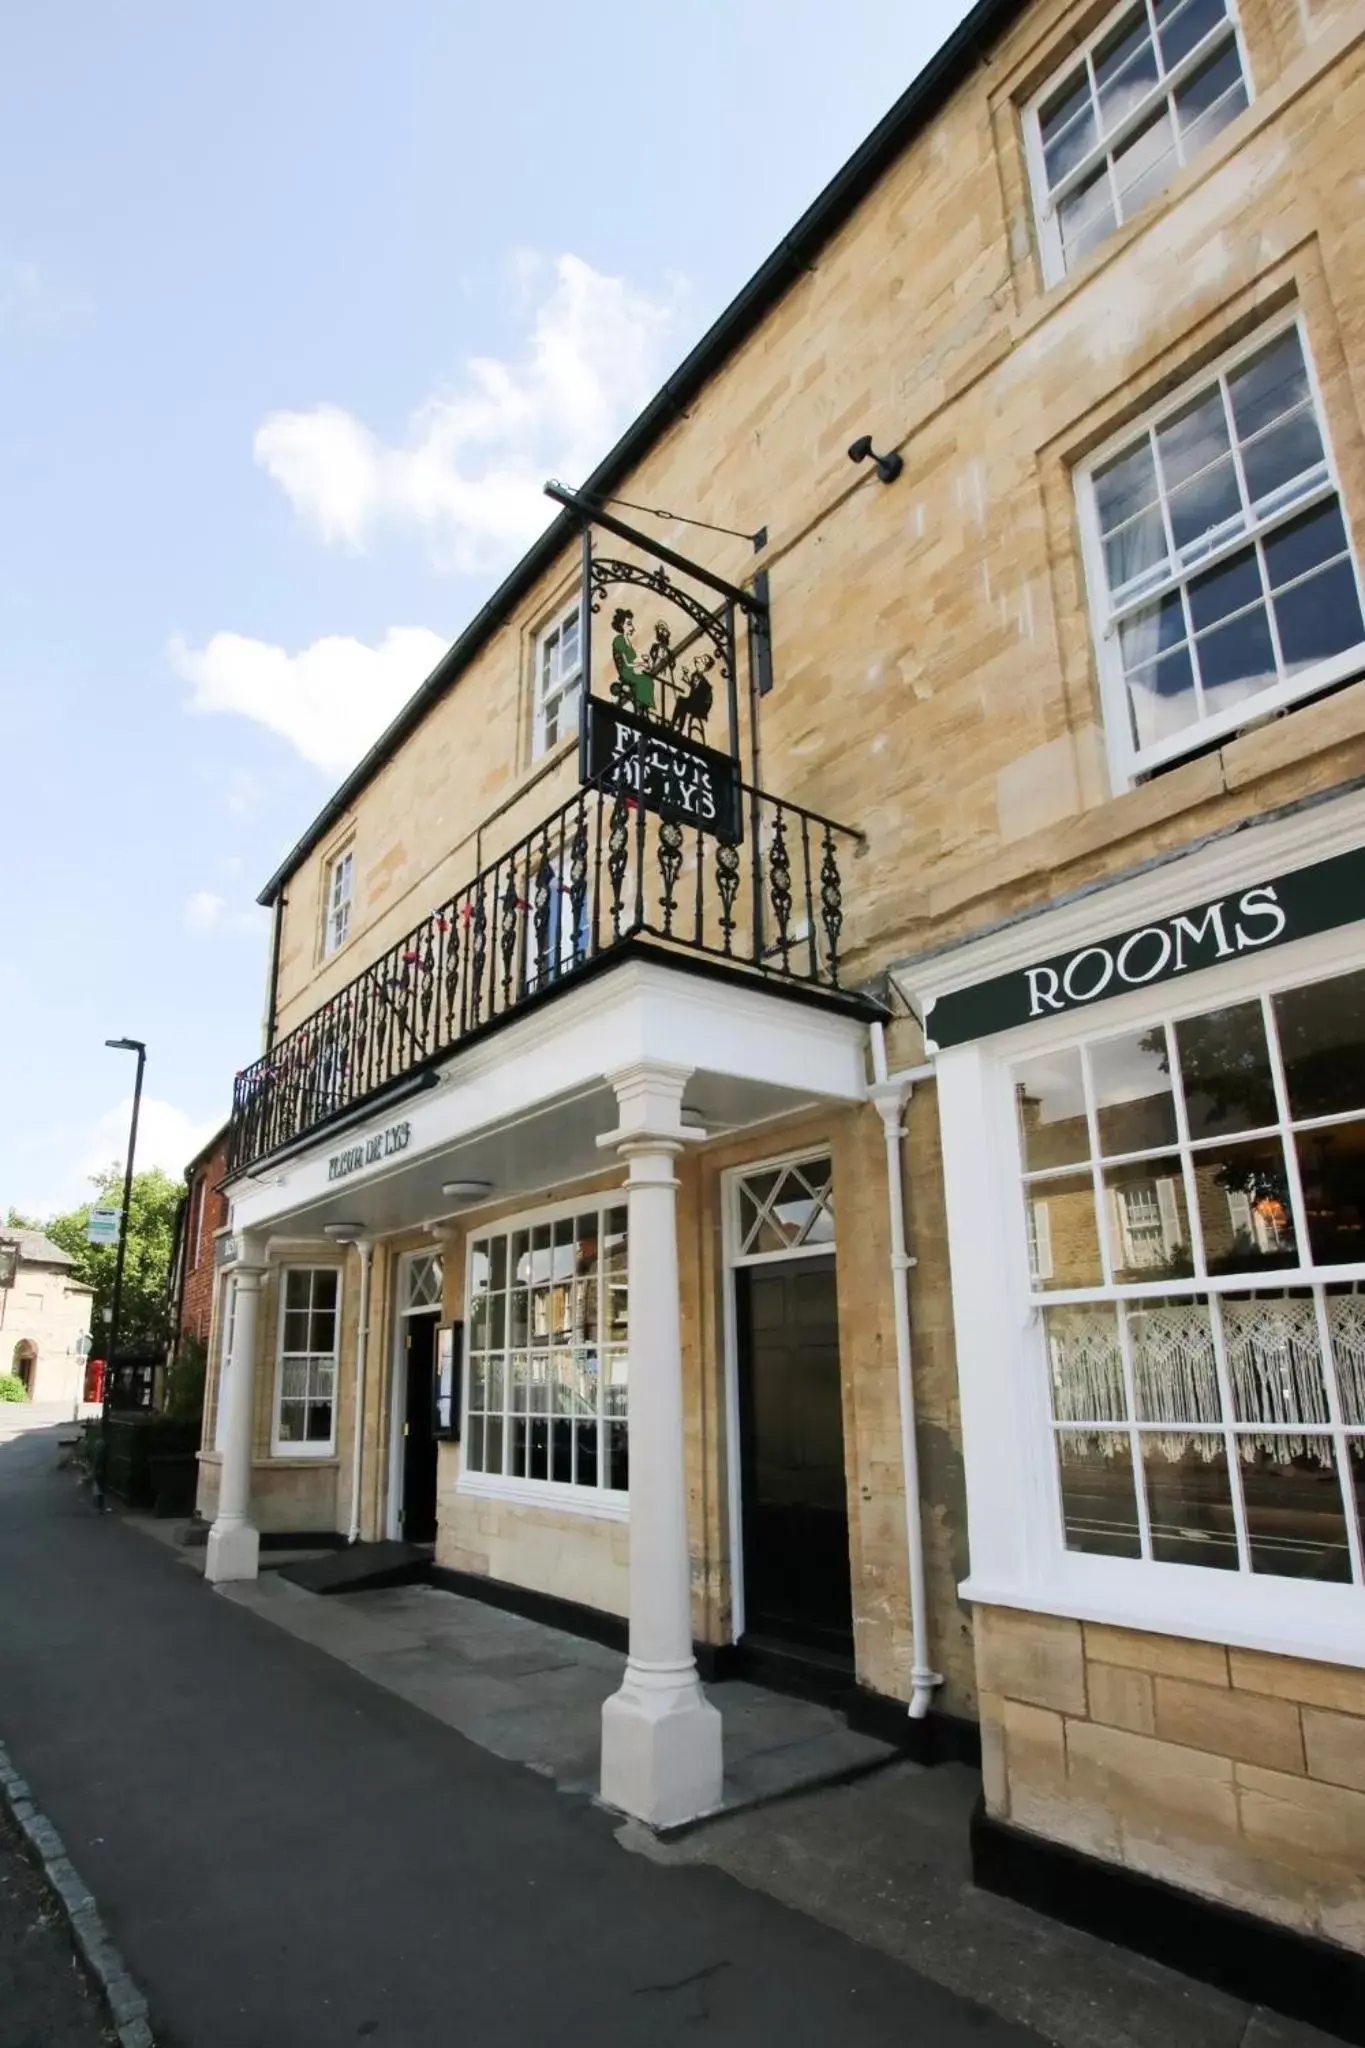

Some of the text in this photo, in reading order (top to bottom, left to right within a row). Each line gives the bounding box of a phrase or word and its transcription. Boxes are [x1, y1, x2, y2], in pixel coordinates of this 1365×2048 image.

[1023, 886, 1286, 1016] ROOMS
[328, 1121, 410, 1180] FLEUR DE LYS
